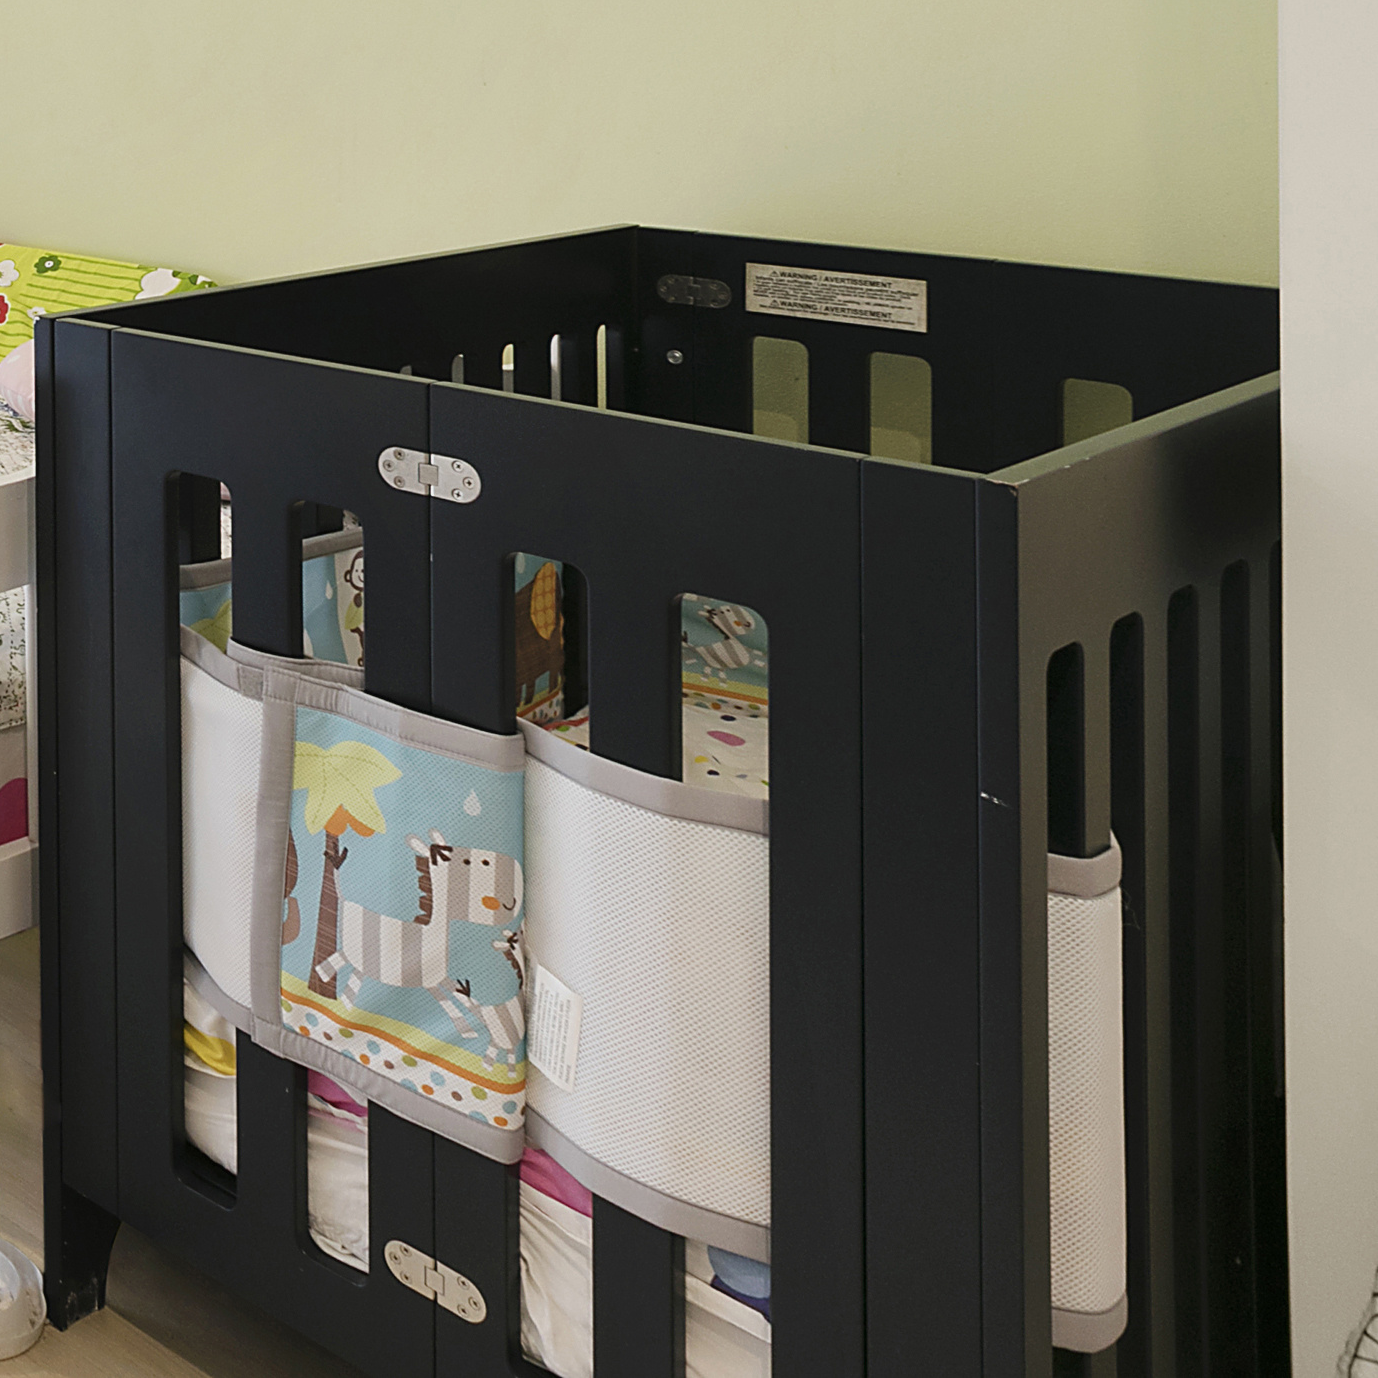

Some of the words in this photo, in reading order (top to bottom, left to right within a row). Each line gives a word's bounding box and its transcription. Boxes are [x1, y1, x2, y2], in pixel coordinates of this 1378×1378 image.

[779, 272, 818, 281] WARNING
[824, 276, 892, 288] AVERTISSEMENT
[779, 300, 818, 310] WARNING
[824, 305, 892, 318] AVERTISSEMENT
